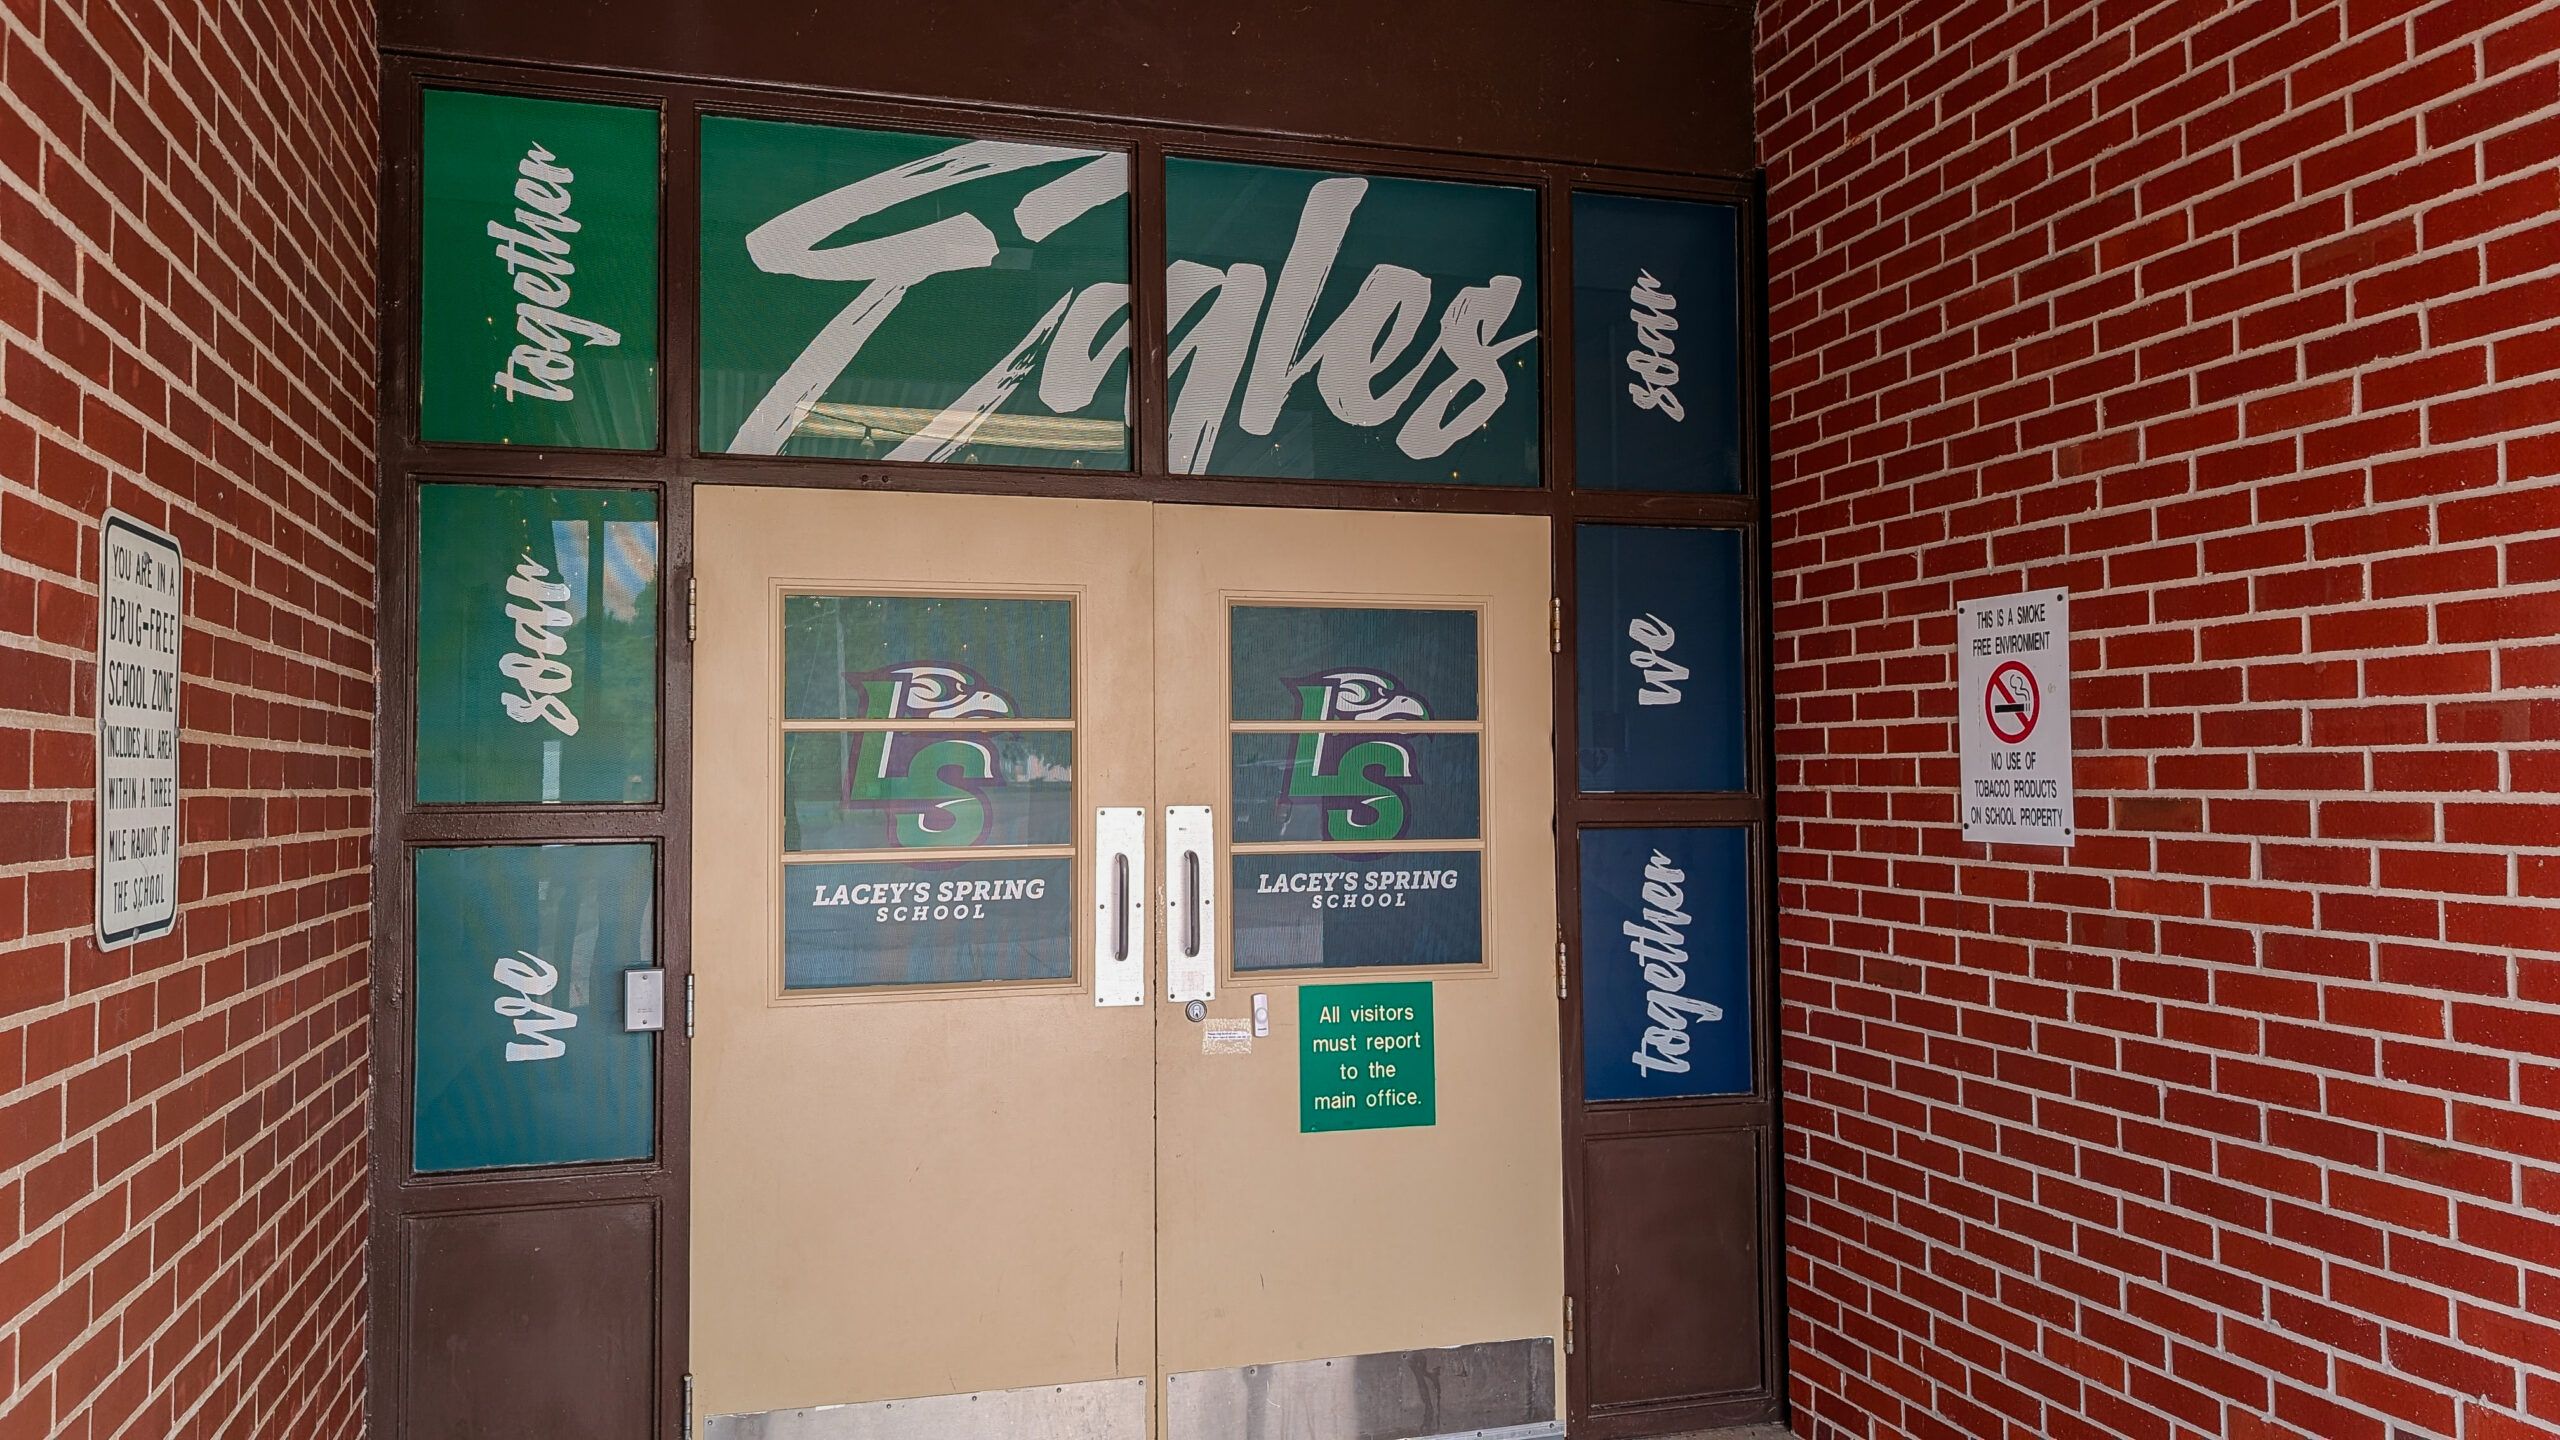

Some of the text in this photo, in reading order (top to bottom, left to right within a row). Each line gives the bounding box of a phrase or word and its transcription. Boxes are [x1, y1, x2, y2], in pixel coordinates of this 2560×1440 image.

[487, 141, 621, 402] together
[724, 138, 1540, 476] Eagles
[1626, 267, 1685, 422] soar
[113, 544, 175, 597] YOU ARE IN A
[110, 596, 175, 655] DRUG-FREE
[1977, 603, 2046, 629] THIS IS A SMOKE
[499, 554, 579, 736] soar
[1628, 612, 1690, 705] we
[1973, 631, 2050, 657] FREE ENVIRONMENT
[108, 660, 174, 712] SCHOOL ZONE
[107, 725, 173, 760] INCLUDES ALL AREA
[1991, 752, 2036, 770] NO USE OF
[108, 777, 172, 809] WITHIN A THREE
[1974, 780, 2057, 799] TOBACCO PRODUCTS
[1971, 806, 2063, 827] ON SCHOOL PROPERTY
[109, 826, 171, 862] MILE RADIUS OF
[113, 874, 165, 914] THE SCHOOL
[812, 878, 1045, 906] LACEY'S SPRING
[1257, 870, 1458, 894] LACEY'S SPRING
[876, 904, 985, 922] SCHOOL
[1312, 893, 1406, 909] SCHOOL
[1623, 848, 1723, 1078] together
[494, 950, 578, 1061] we
[1319, 1004, 1414, 1023] All visitors
[1313, 1031, 1421, 1052] must report
[1340, 1061, 1396, 1079] to the
[1314, 1088, 1421, 1110] main office.
